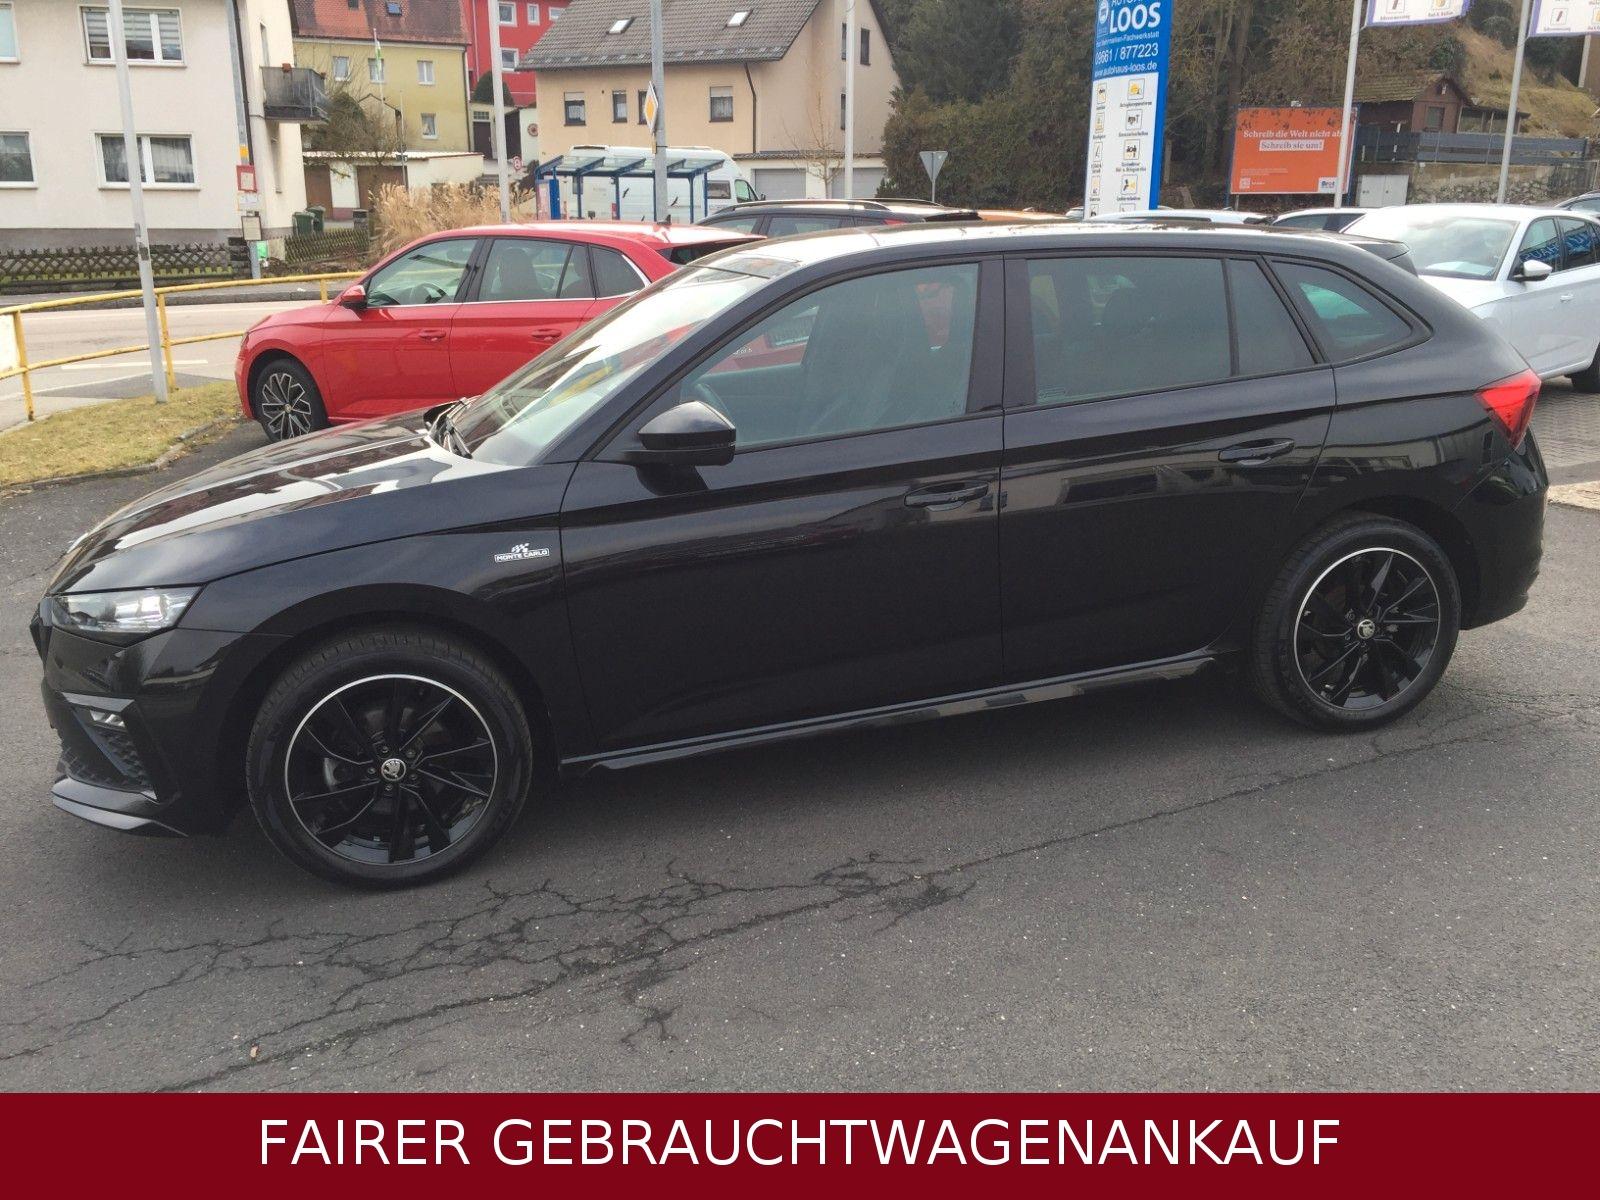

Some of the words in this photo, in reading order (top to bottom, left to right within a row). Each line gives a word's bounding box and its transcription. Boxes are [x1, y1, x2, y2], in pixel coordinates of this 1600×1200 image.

[1109, 2, 1161, 33] LOOS
[1120, 42, 1159, 60] 877223
[1243, 129, 1274, 138] Schreib
[1275, 129, 1288, 138] die
[1290, 129, 1308, 138] Welt
[1310, 129, 1330, 138] nicht
[1261, 141, 1292, 149] Schreib
[1293, 141, 1304, 149] sie
[1306, 141, 1322, 149] um!
[496, 553, 522, 561] MONTE
[523, 550, 548, 558] CARLO
